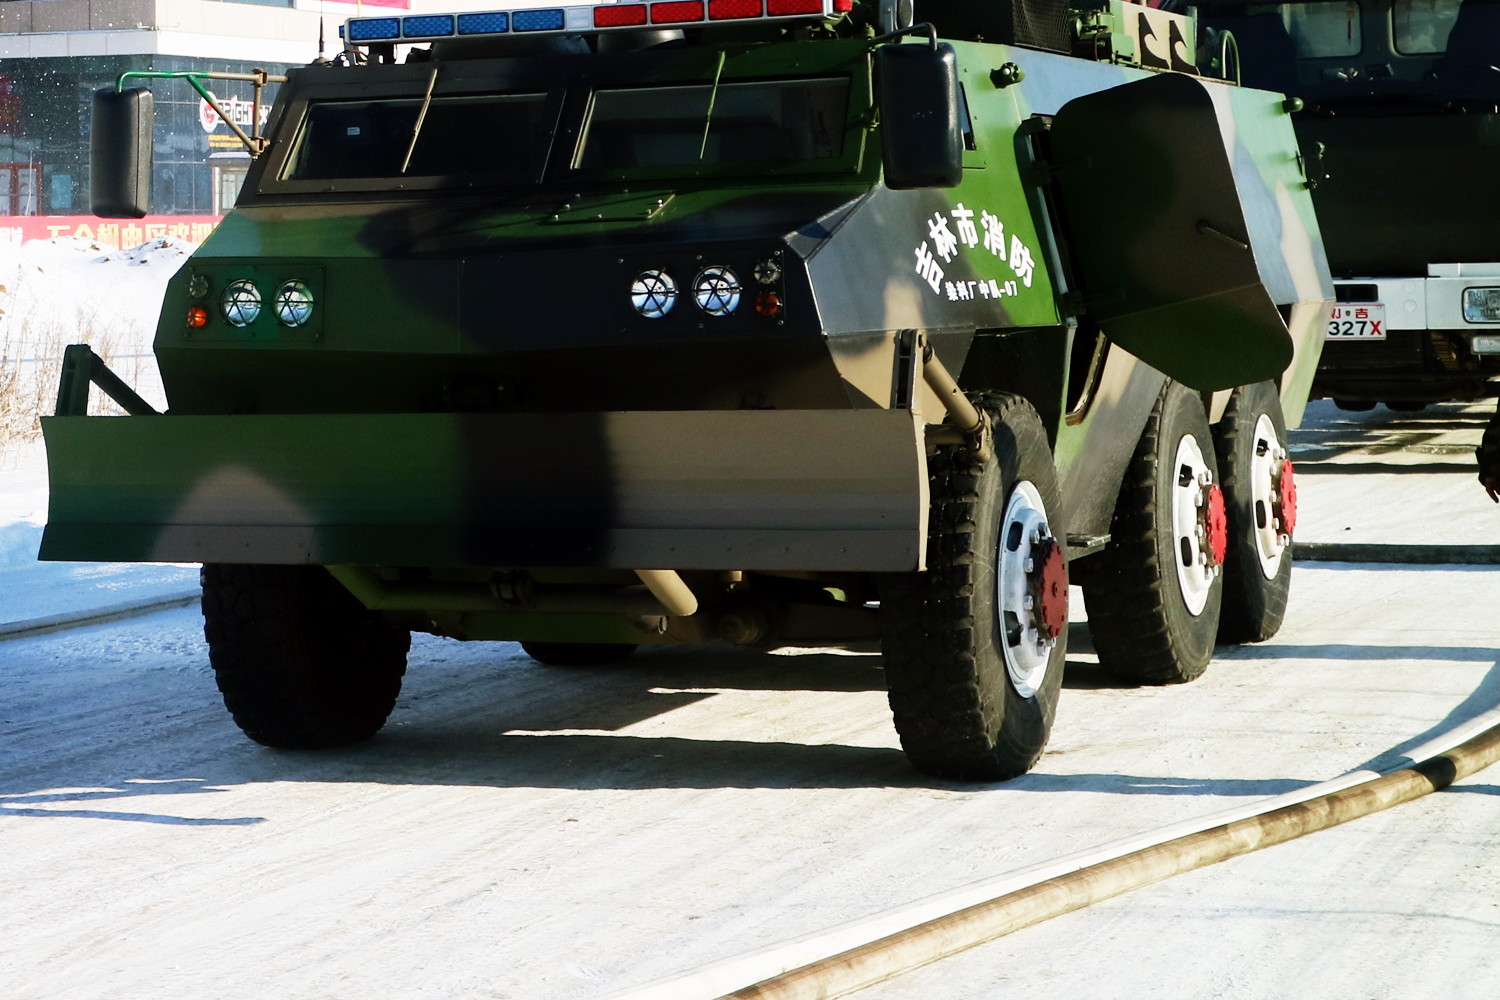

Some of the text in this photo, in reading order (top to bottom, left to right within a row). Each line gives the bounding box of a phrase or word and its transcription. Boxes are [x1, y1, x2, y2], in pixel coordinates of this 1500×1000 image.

[914, 202, 1035, 295] 吉林市消防
[1355, 308, 1368, 319] 吉
[1328, 320, 1382, 336] 327X
